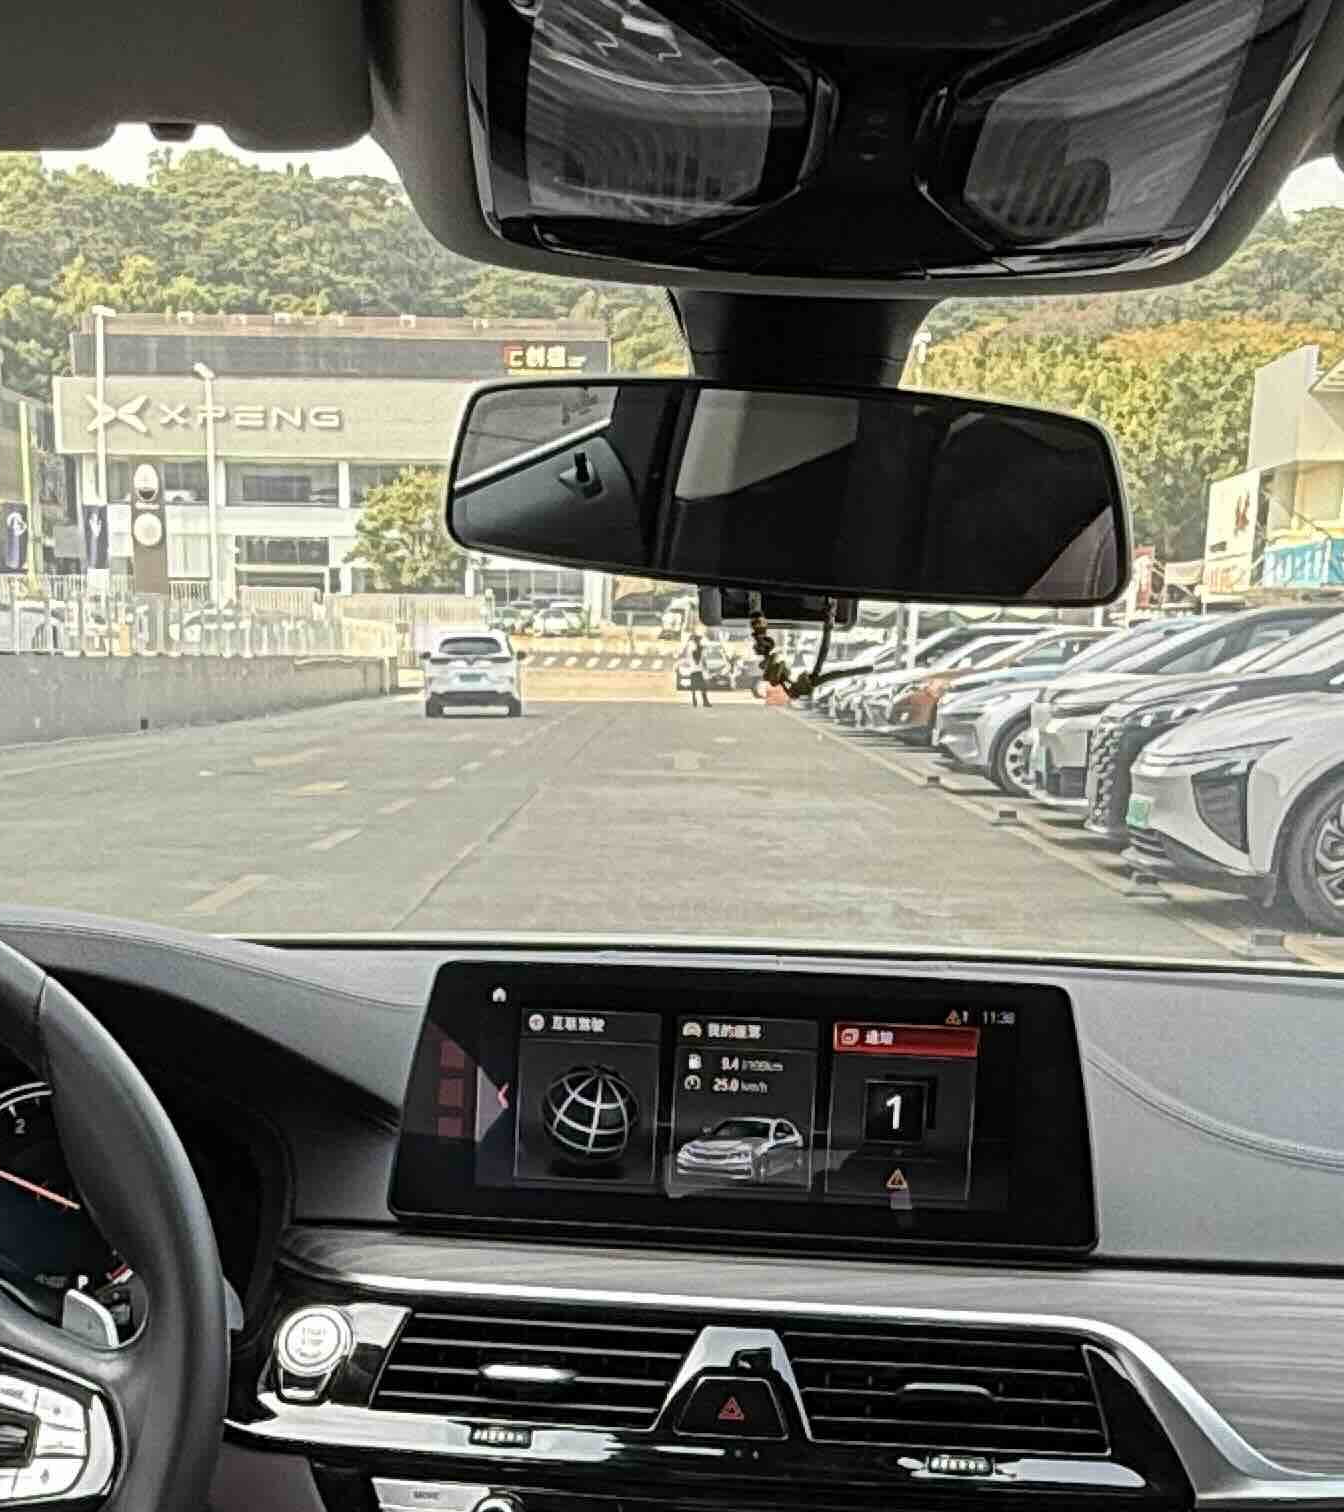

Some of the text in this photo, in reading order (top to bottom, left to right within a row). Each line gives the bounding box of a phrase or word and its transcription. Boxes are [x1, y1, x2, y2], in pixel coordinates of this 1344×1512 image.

[158, 402, 344, 429] XPENG
[885, 1094, 903, 1130] 1
[14, 1117, 26, 1135] 2
